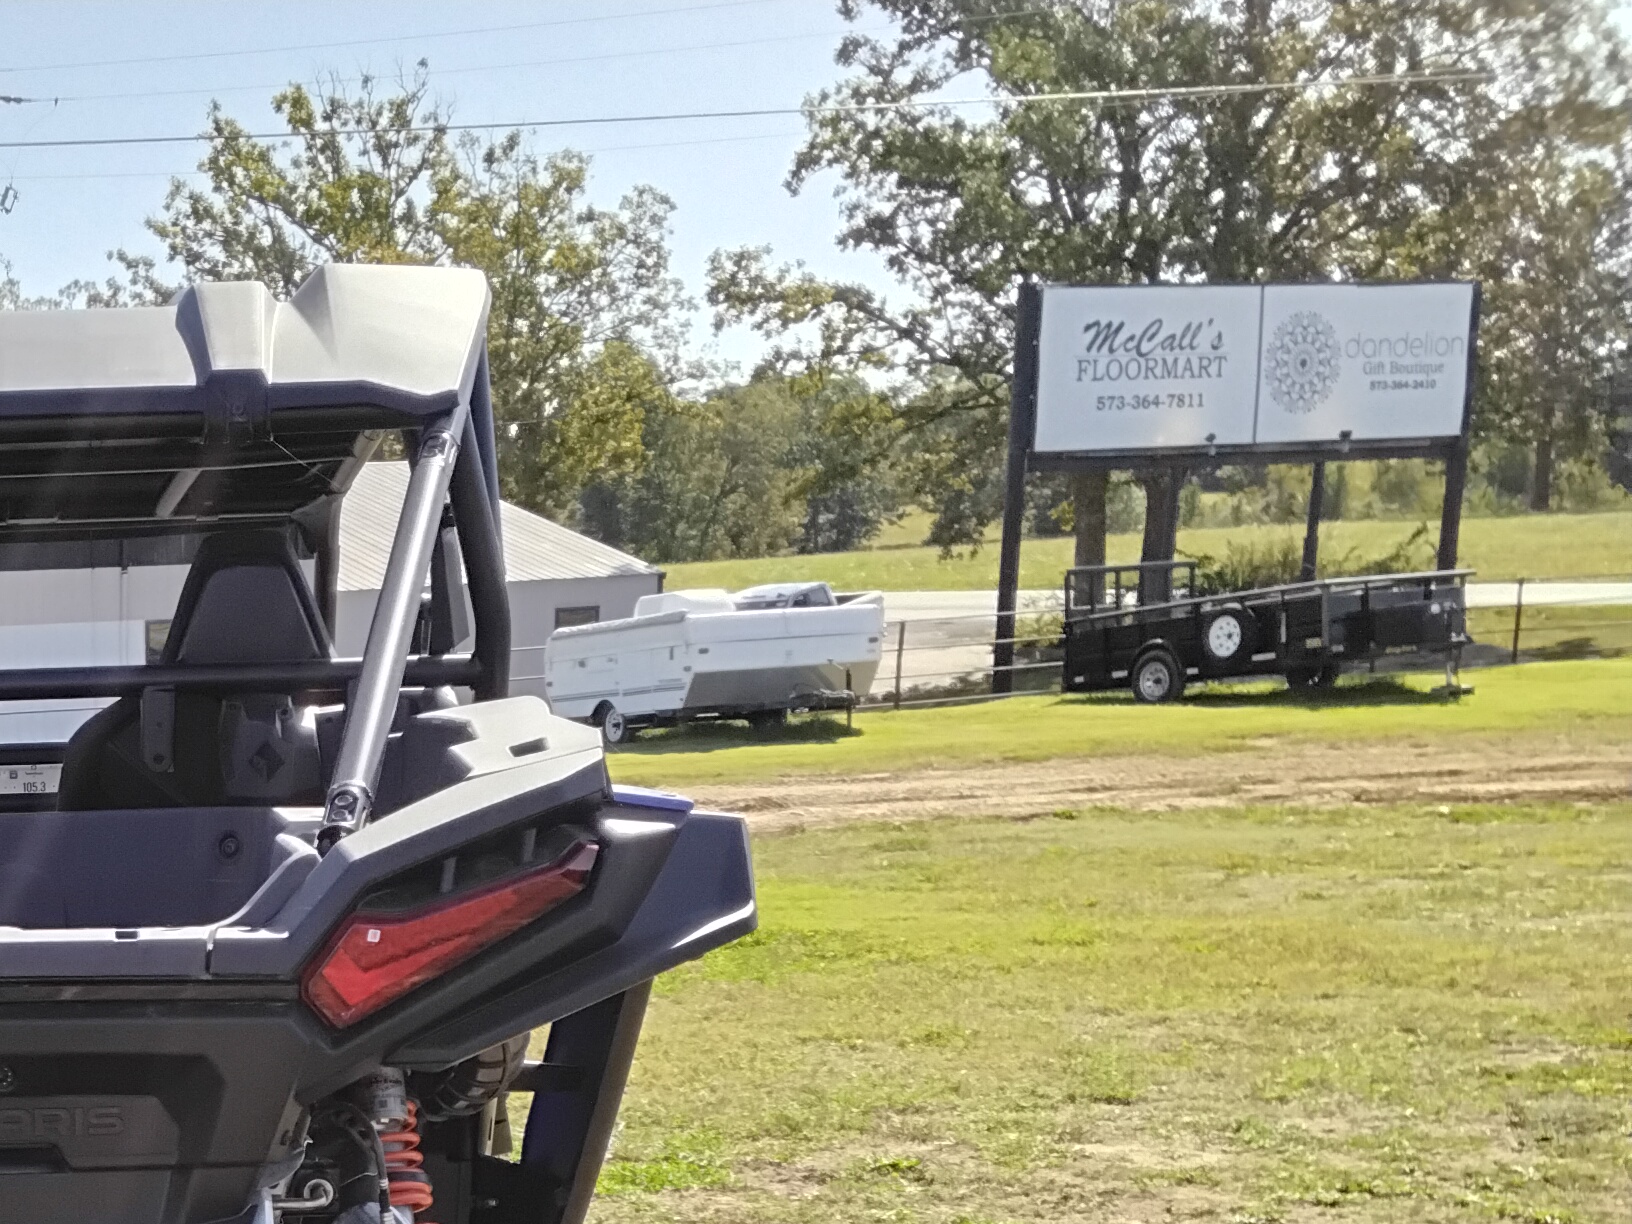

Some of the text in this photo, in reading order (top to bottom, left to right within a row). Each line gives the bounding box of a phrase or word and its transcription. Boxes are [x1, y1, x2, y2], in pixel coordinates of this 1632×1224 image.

[1083, 318, 1224, 357] McCall's
[1345, 331, 1465, 358] dandelion
[1076, 356, 1228, 382] FLOORMART
[1363, 361, 1445, 377] Gift Boutique
[1096, 393, 1204, 411] 573-364-7811
[22, 781, 47, 793] 105.3
